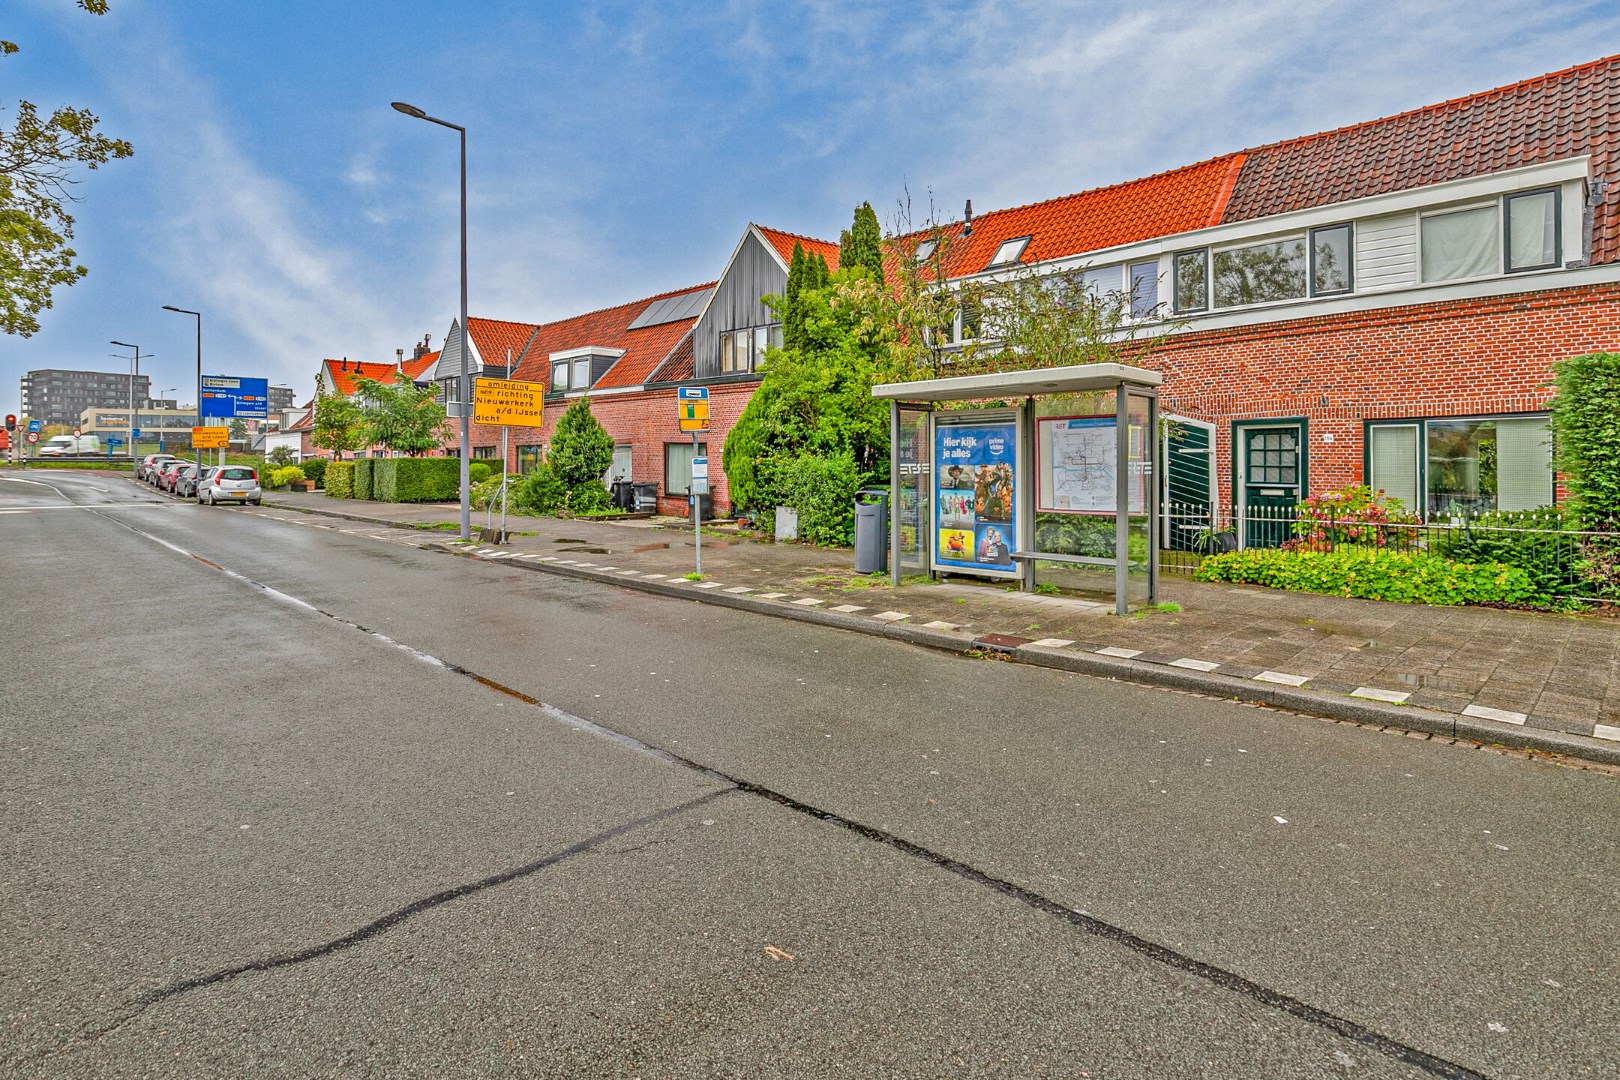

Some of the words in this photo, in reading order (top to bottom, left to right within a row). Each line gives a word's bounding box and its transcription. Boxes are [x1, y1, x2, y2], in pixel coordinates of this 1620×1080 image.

[488, 382, 529, 391] omleiding
[497, 391, 534, 400] richting
[477, 397, 534, 407] Nieuwerkerk
[495, 407, 512, 415] a/d
[475, 414, 500, 422] dicht
[943, 437, 961, 447] Hier
[961, 436, 977, 449] kijk
[942, 449, 951, 460] je
[951, 448, 971, 458] alles
